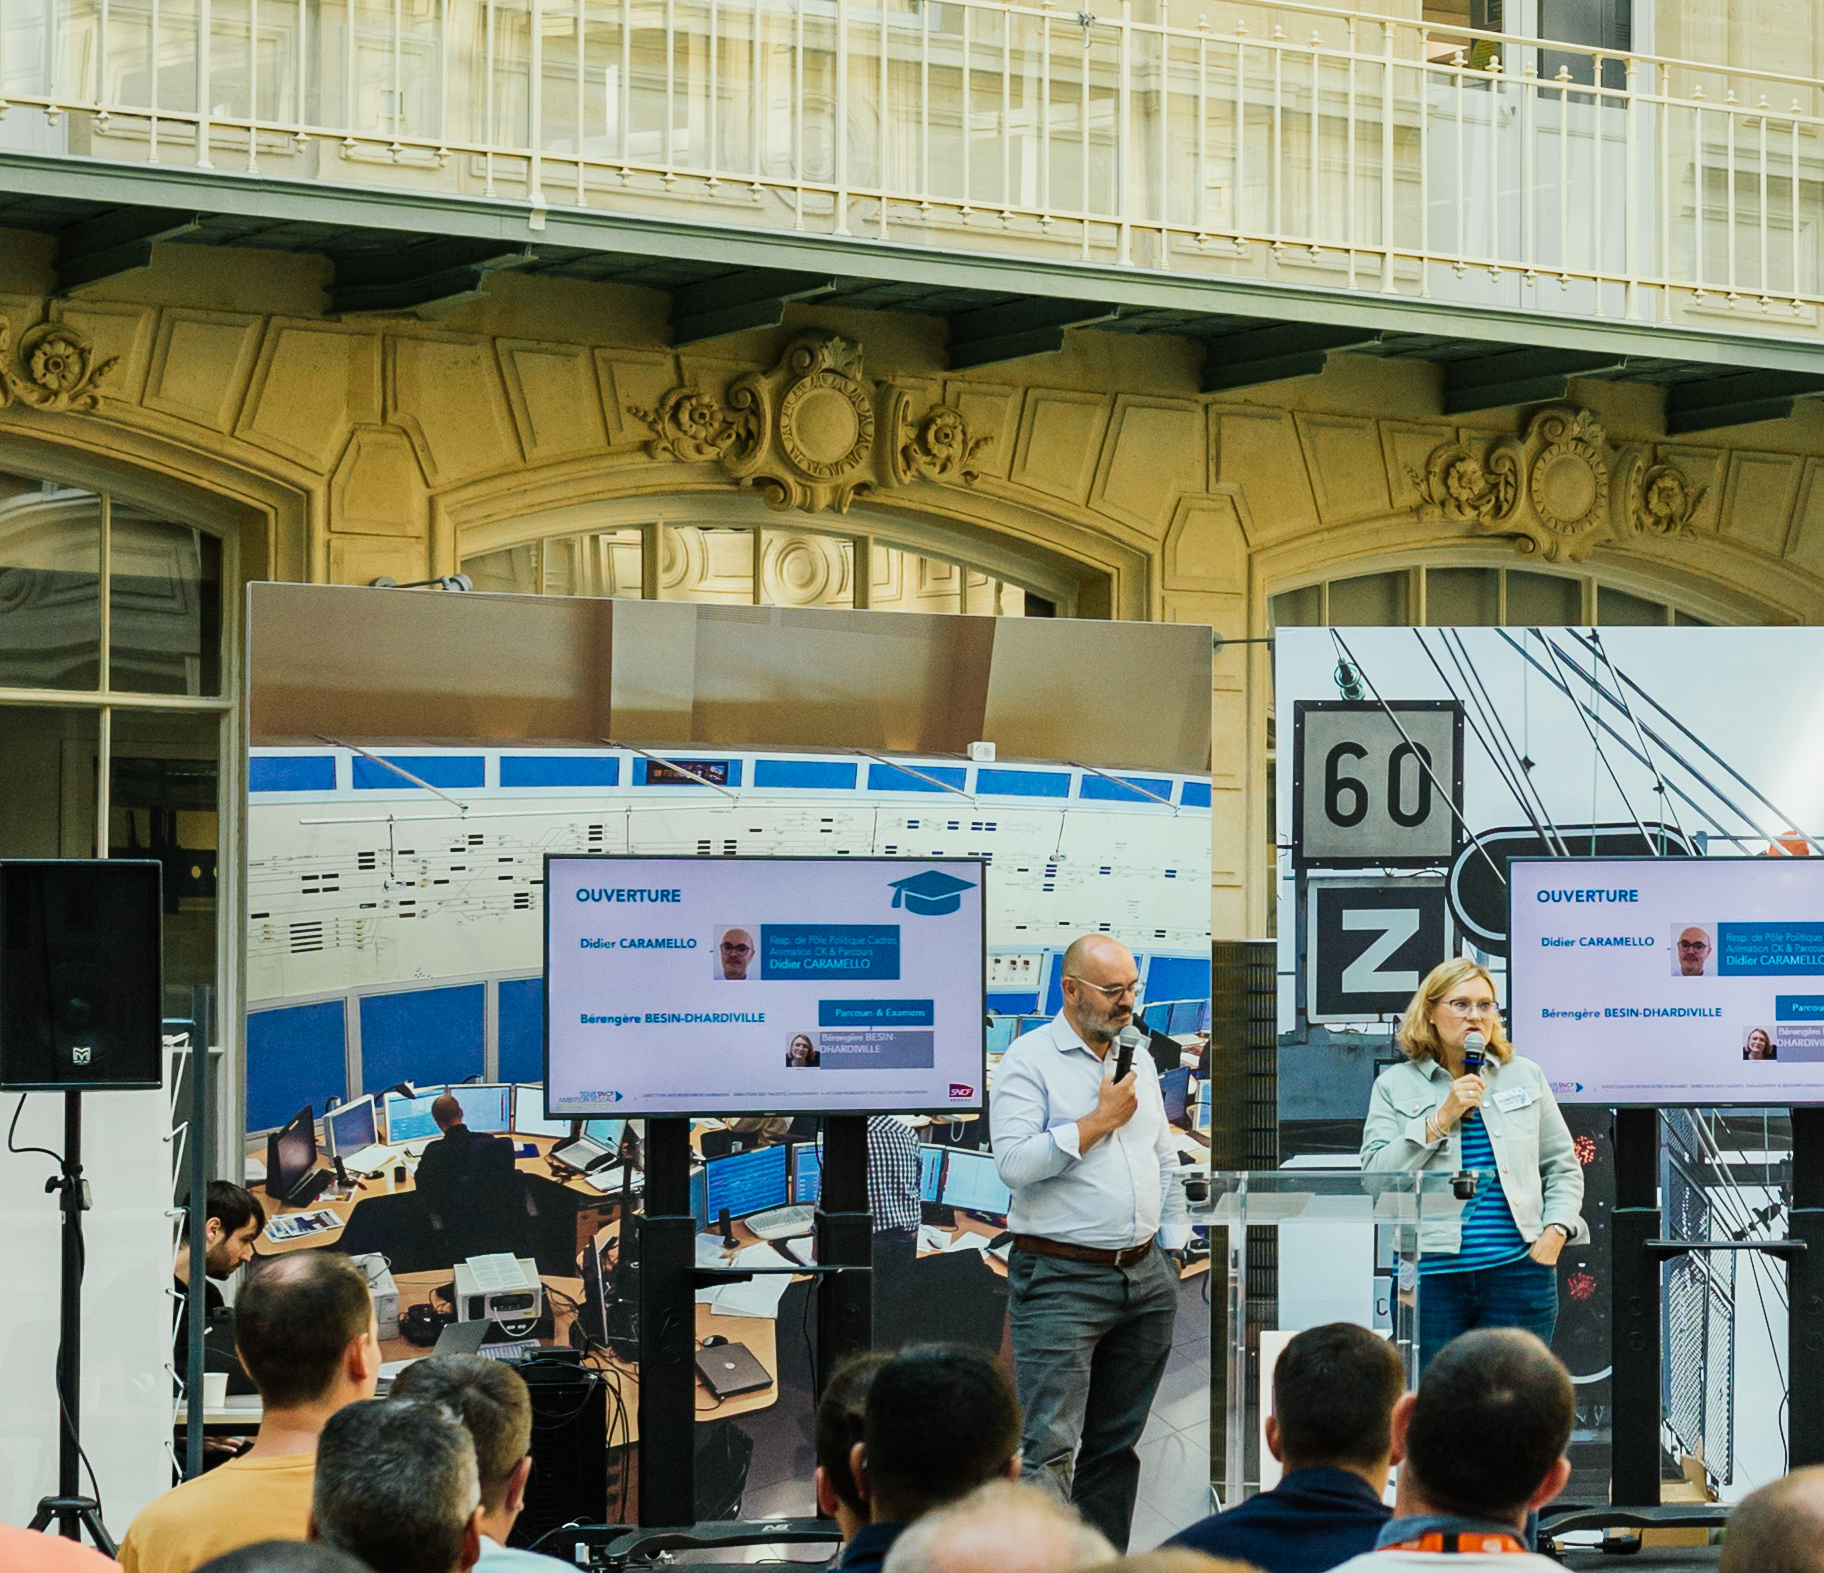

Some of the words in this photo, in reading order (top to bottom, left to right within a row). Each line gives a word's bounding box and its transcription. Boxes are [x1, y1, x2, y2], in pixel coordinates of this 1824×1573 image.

[1325, 741, 1432, 828] 60
[576, 888, 681, 903] OUVERTURE
[1537, 889, 1639, 903] OUVERTURE
[580, 937, 617, 949] Didier
[619, 937, 698, 949] CARAMELLO
[1541, 936, 1576, 947] Didier
[1578, 936, 1655, 947] CARAMELLO
[1342, 908, 1420, 994] Z
[769, 958, 801, 969] Didier
[803, 958, 871, 969] CARAMELLO
[1726, 955, 1758, 966] Didier
[580, 1012, 642, 1026] Bérengère
[645, 1012, 766, 1024] BESIN-DHARDIVILLE
[1541, 1007, 1601, 1020] Bérengère
[1604, 1007, 1722, 1018] BESIN-DHARDIVILLE
[950, 1088, 972, 1096] SNCF
